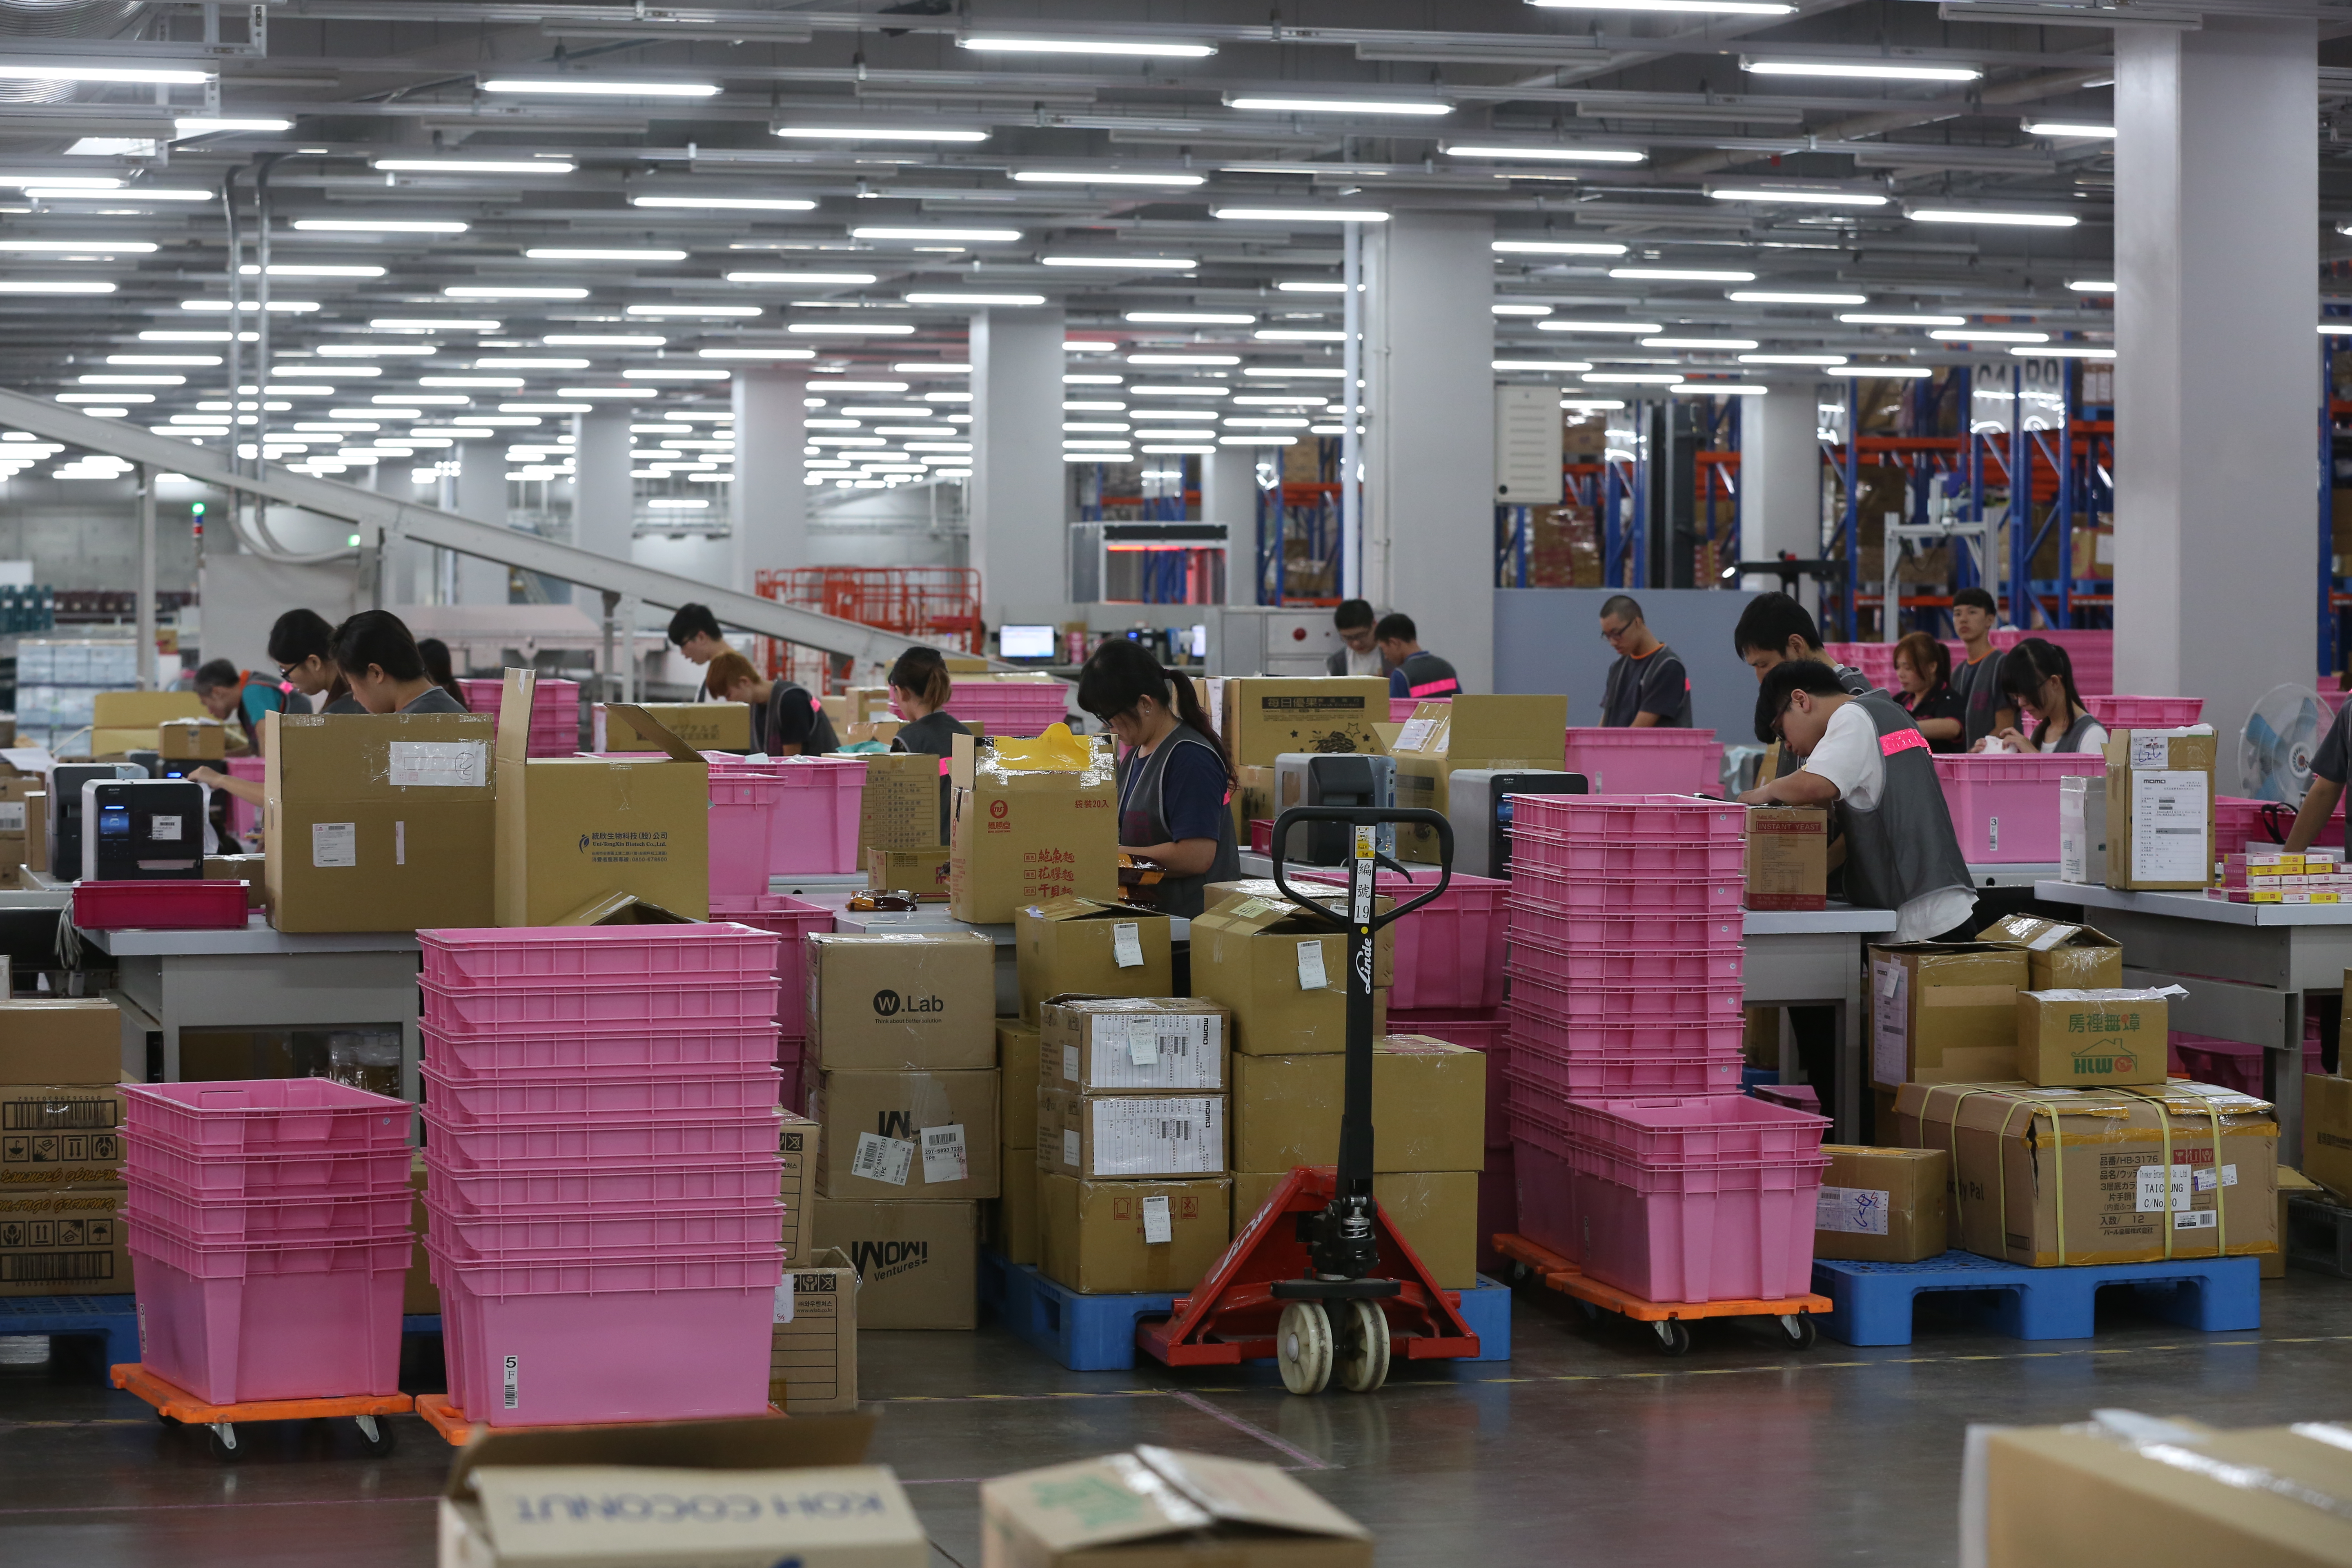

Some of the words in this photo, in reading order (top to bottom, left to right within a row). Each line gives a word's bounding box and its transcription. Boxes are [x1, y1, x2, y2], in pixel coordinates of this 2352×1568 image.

[1075, 800, 1109, 808] 袋裝20入
[1038, 848, 1075, 864] 鮑魚麵
[1038, 866, 1074, 881] 花膠麵
[1356, 938, 1372, 994] Linde
[873, 1152, 883, 1178] 297-6893
[2100, 1155, 2158, 1165] 品番/HB-3176
[2140, 1170, 2152, 1178] Thinker
[1970, 1181, 1984, 1200] Pal
[2100, 1215, 2121, 1225] 入数/
[2132, 1215, 2144, 1223] 12
[1211, 1202, 1272, 1284] Linde
[874, 1259, 920, 1282] Ventures
[506, 1357, 517, 1368] 5
[508, 1370, 515, 1379] F
